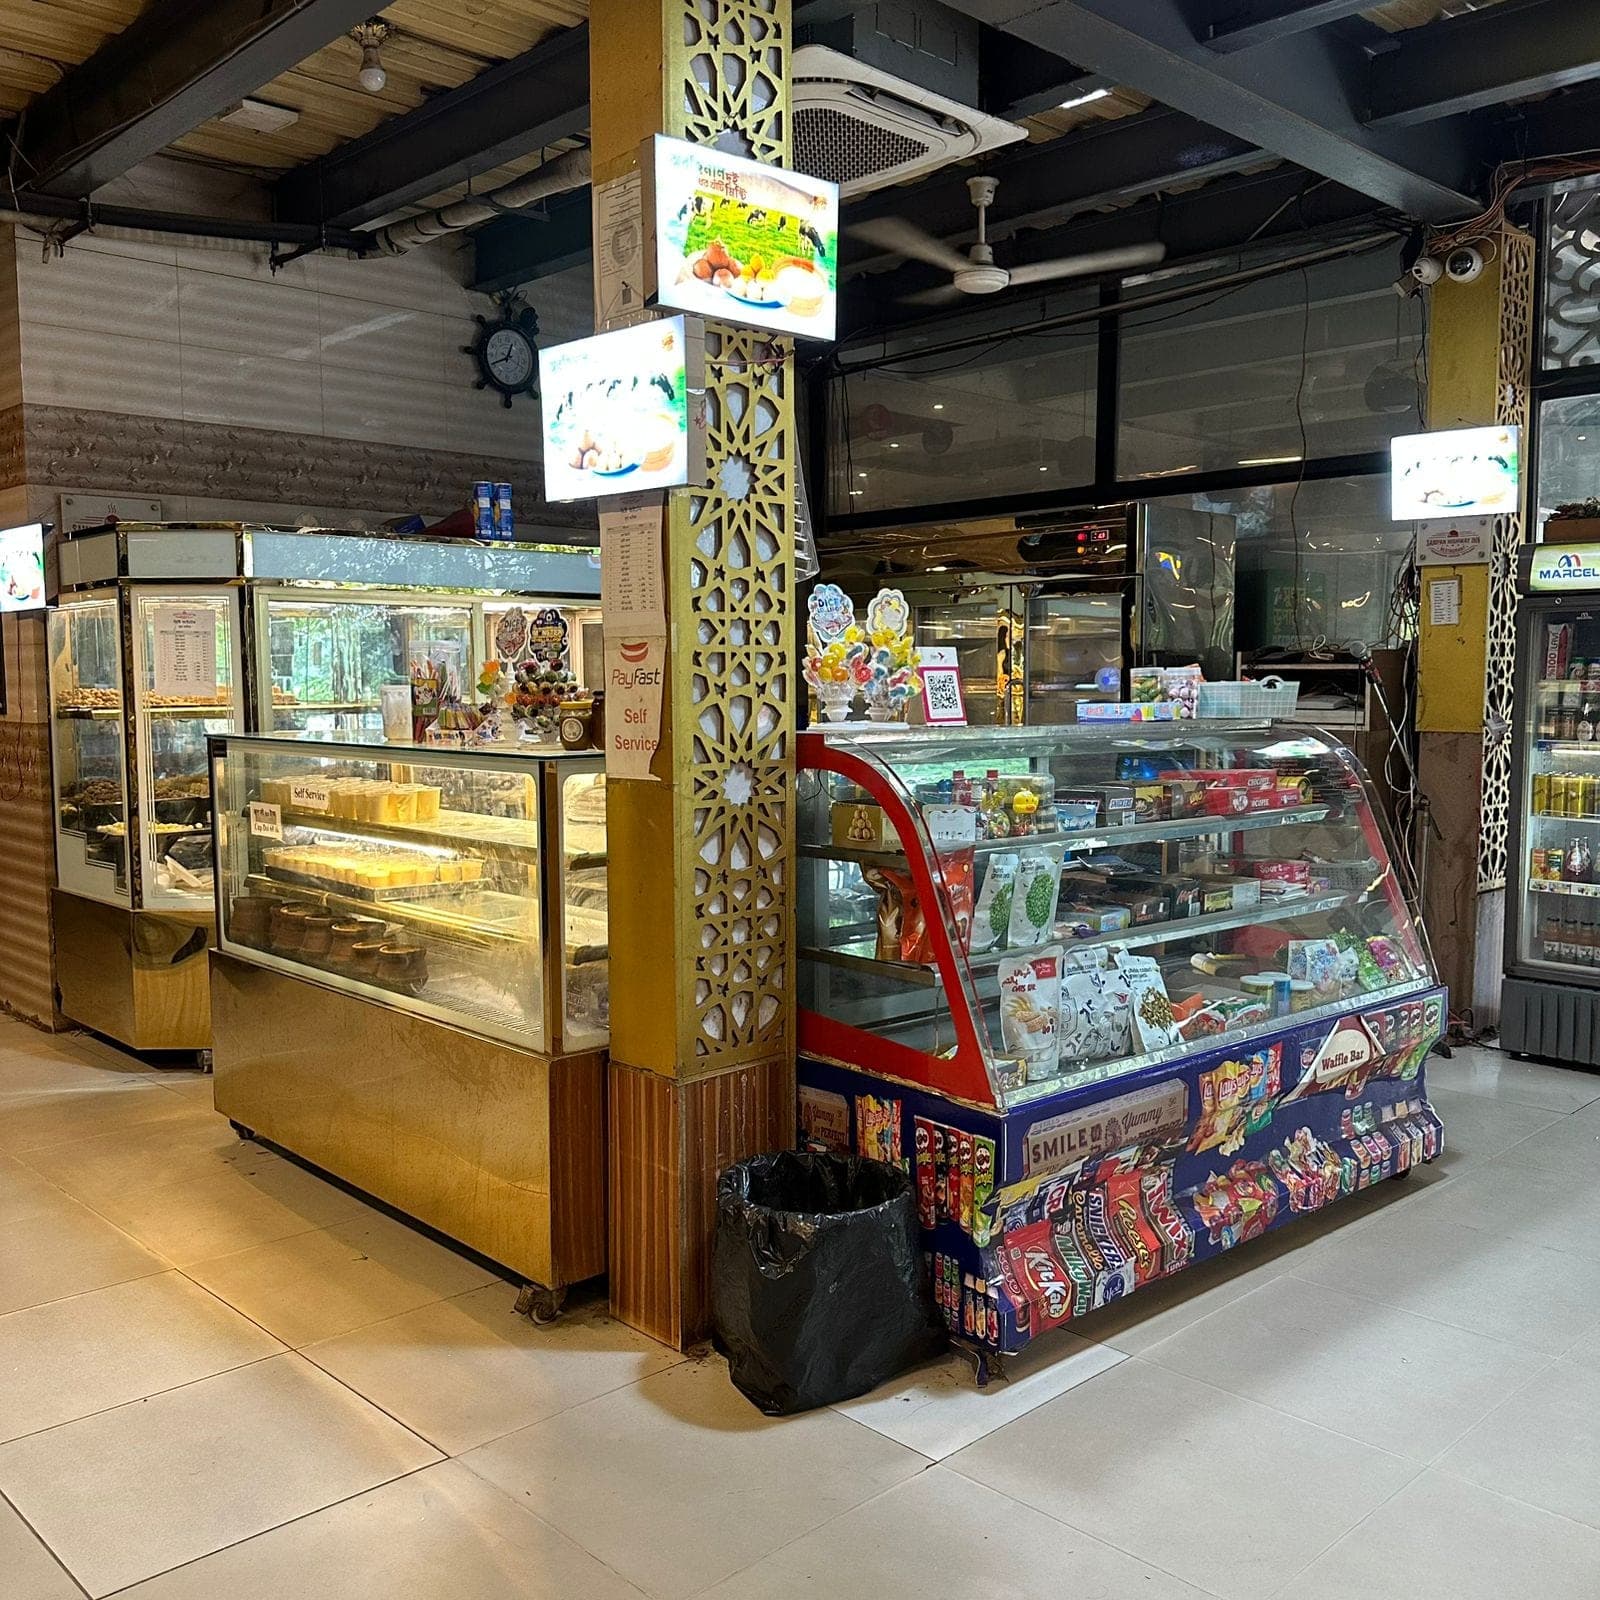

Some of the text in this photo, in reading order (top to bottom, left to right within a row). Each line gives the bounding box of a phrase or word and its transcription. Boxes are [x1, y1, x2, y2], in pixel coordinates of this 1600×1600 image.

[1539, 567, 1600, 579] MARCEL
[624, 708, 648, 724] Self
[614, 734, 658, 751] Service
[294, 787, 326, 801] Self Service
[1110, 797, 1132, 810] SNICKERS
[1259, 863, 1283, 874] Sport
[1321, 1049, 1365, 1071] Waffle Bar
[1122, 1106, 1163, 1136] Yummy
[1032, 1127, 1088, 1164] SMILE
[1072, 1191, 1104, 1271] Caramello
[1024, 1249, 1068, 1317] Kit Kat
